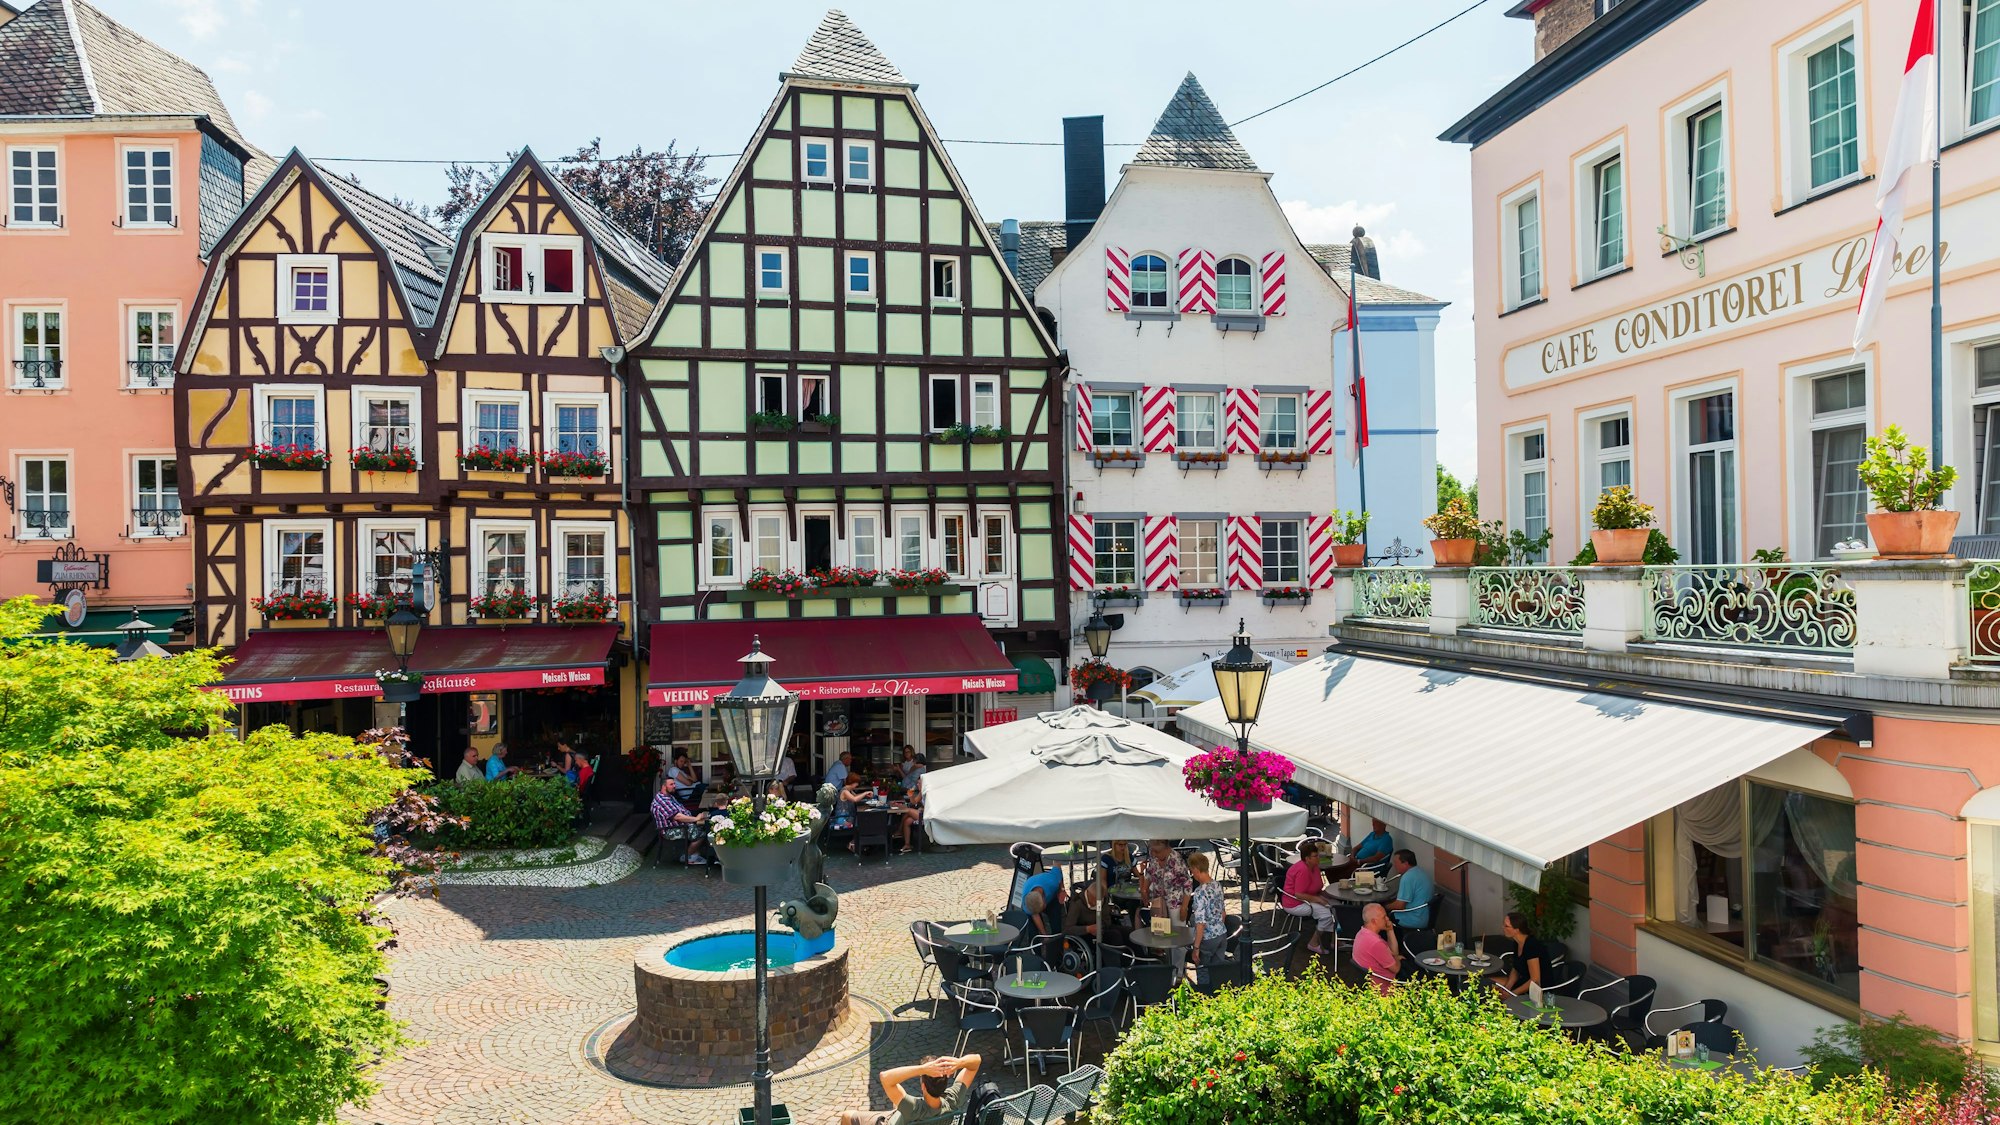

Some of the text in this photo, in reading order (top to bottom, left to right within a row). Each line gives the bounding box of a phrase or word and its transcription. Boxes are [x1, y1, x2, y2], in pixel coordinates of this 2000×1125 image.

[1541, 328, 1598, 374] CAFE
[1614, 262, 1804, 353] CONDITOREI
[1281, 649, 1296, 660] Tapas
[542, 671, 591, 684] Maisel's Weisse
[985, 677, 1006, 689] Weisse
[335, 683, 383, 693] Restaura
[819, 686, 861, 695] Ristorante
[867, 683, 882, 695] da
[884, 679, 930, 695] Nico
[663, 689, 710, 703] VELTINS
